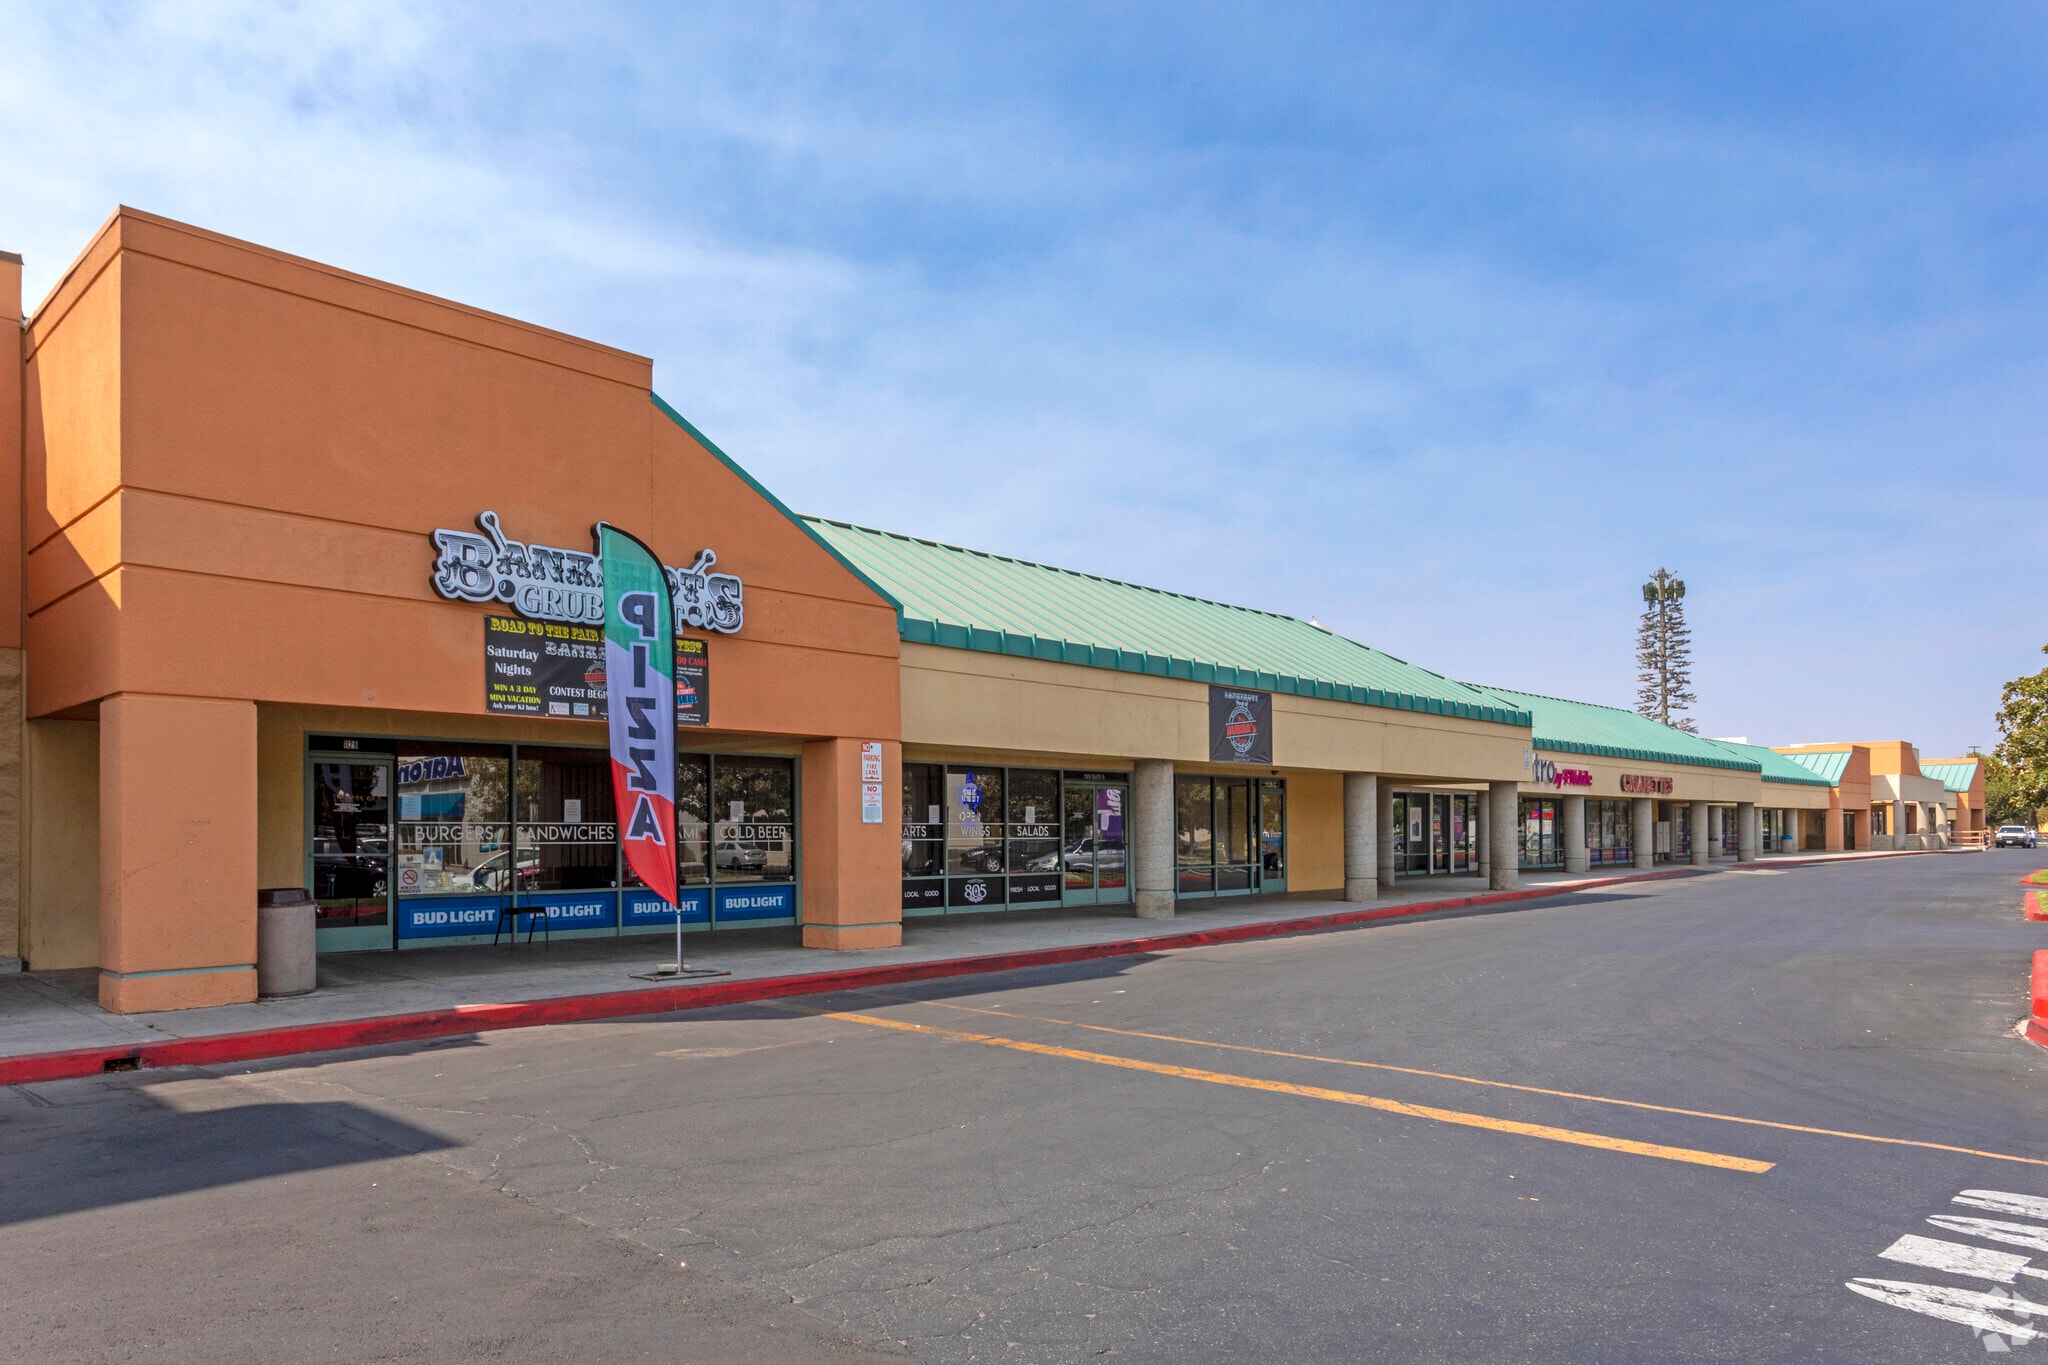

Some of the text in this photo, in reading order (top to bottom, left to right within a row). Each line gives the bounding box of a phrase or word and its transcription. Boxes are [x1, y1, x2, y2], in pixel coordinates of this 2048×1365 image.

[437, 532, 742, 630] BANKTS
[517, 584, 604, 620] GRUB
[490, 617, 526, 634] ROAD
[527, 622, 544, 636] TO
[546, 625, 569, 639] THE
[571, 627, 599, 641] FAIR
[545, 641, 606, 660] BANKS
[676, 639, 702, 653] TEST
[487, 645, 539, 662] Saturday
[676, 656, 707, 667] 00 CASH
[495, 662, 532, 676] Nights
[493, 683, 537, 694] WIN A 3 DAY
[549, 686, 585, 698] CONTEST
[490, 693, 541, 704] MINI VACATION
[862, 743, 869, 751] NO
[863, 754, 880, 762] PARKING
[1533, 753, 1555, 783] tro
[414, 826, 494, 841] BURGERS
[516, 826, 615, 841] SANDWICHES
[720, 826, 786, 838] COLD BEER
[902, 826, 927, 838] ARTS
[961, 826, 991, 837] WINGS
[1017, 826, 1049, 837] SALADS
[964, 883, 987, 899] 805
[633, 901, 661, 913] BUD
[725, 896, 783, 908] BUD LIGHT
[562, 905, 602, 917] LIGHT
[413, 910, 495, 925] BUD LIGHT
